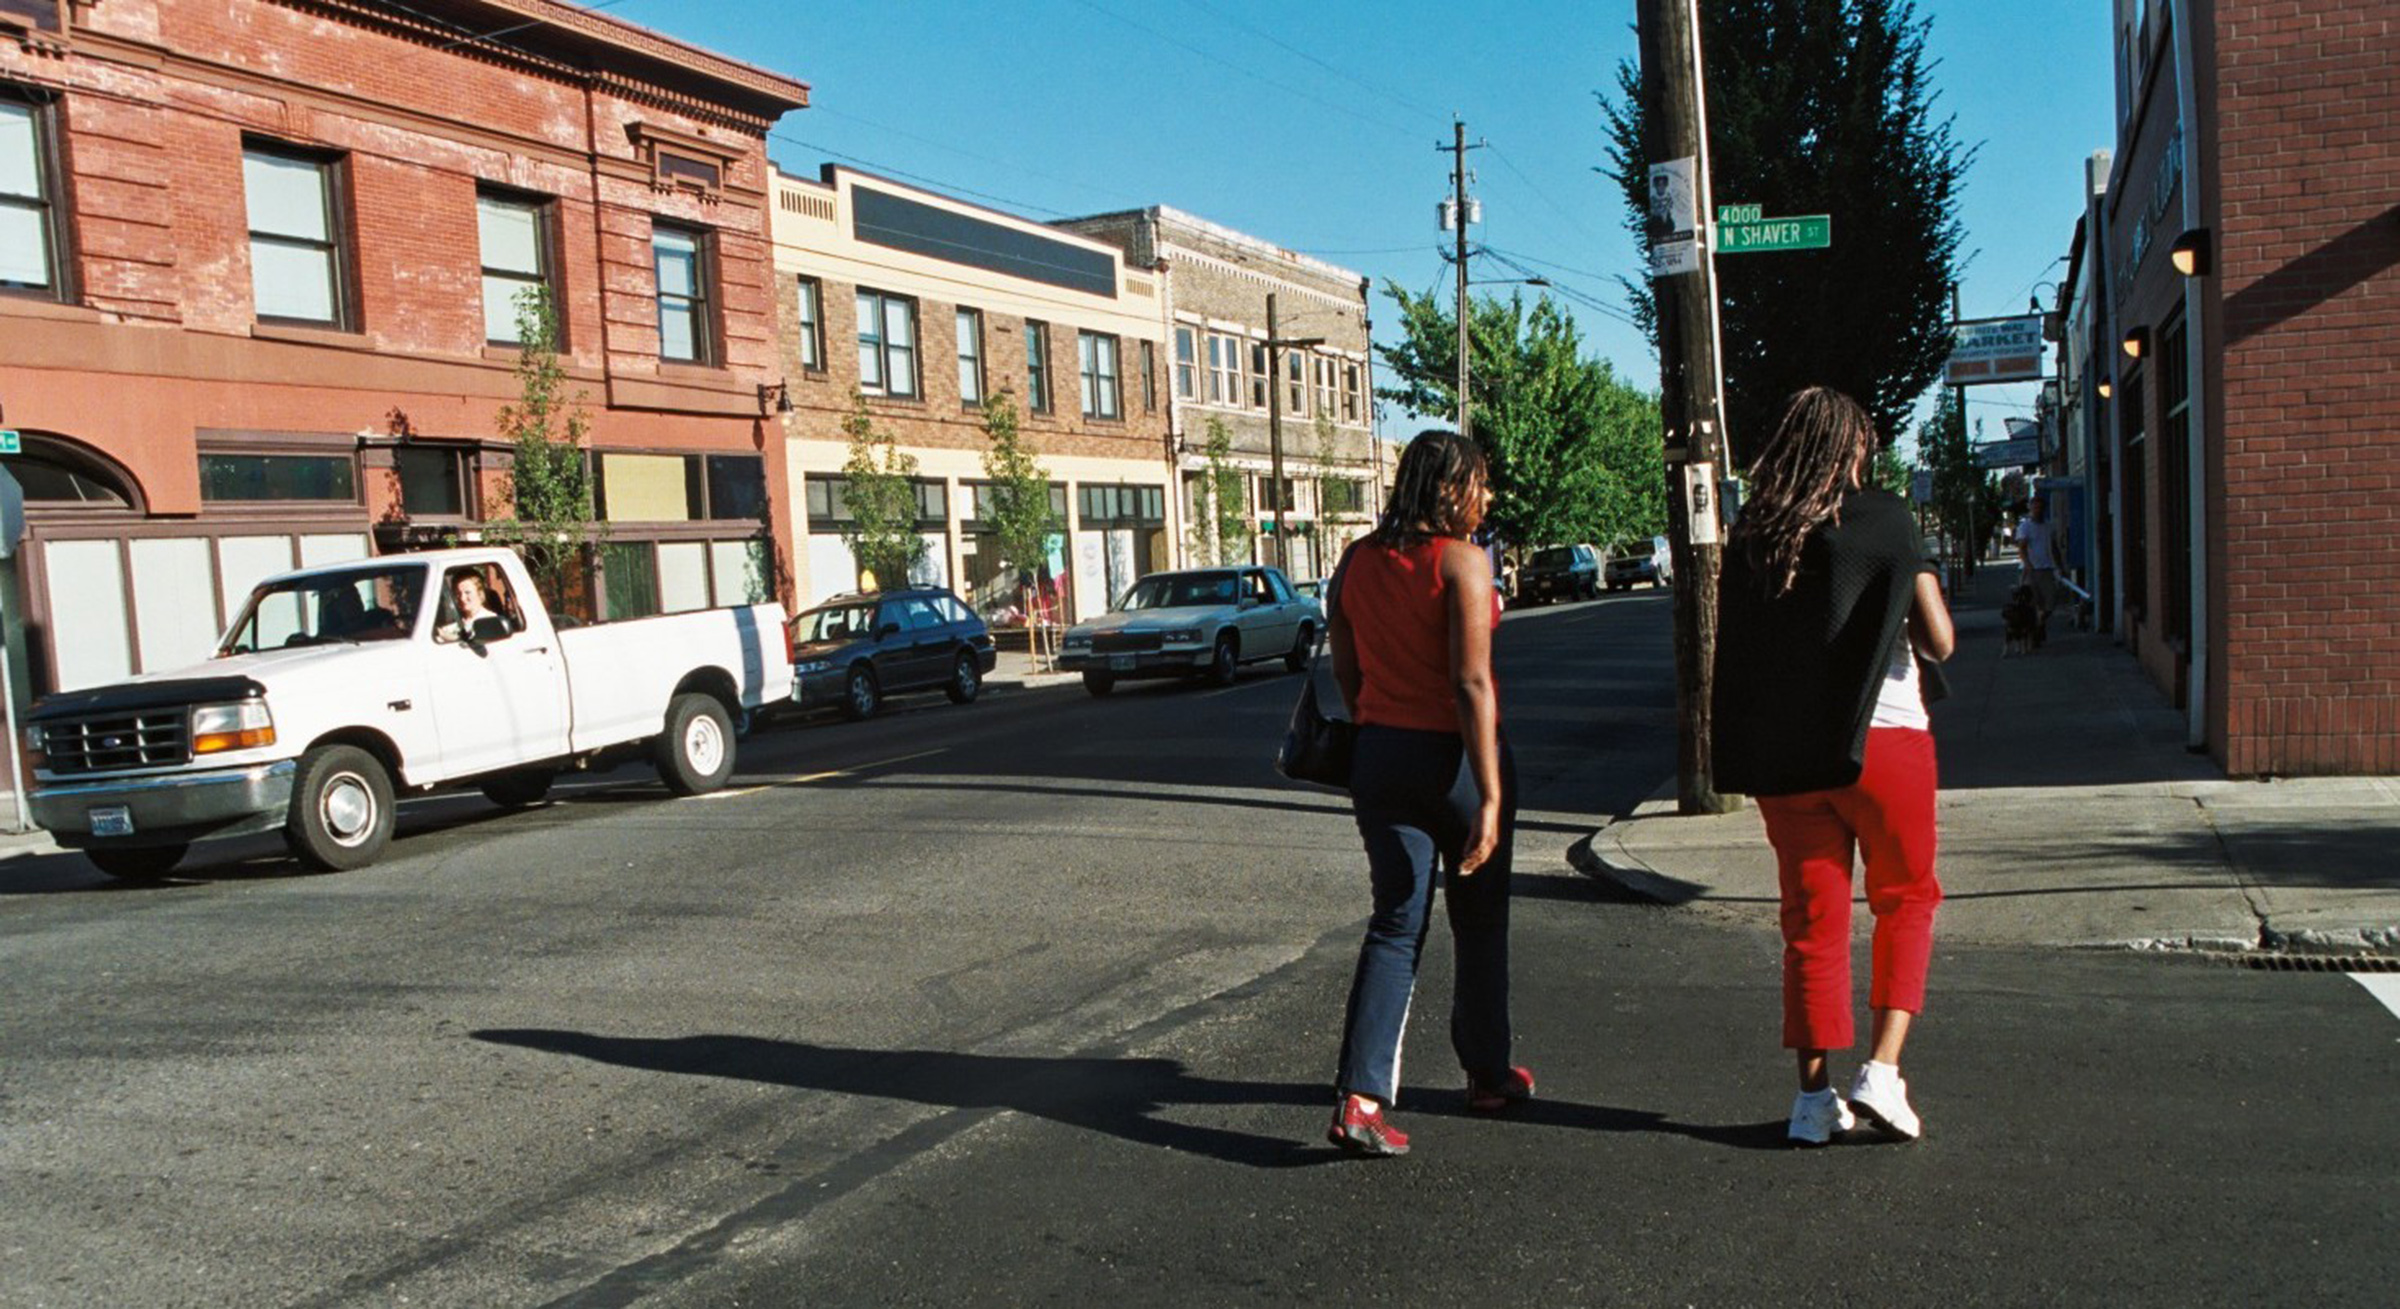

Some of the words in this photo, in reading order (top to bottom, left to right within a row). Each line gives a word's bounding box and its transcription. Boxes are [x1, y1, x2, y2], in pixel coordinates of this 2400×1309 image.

[1721, 206, 1760, 224] 4000
[1724, 226, 1735, 247] N
[1741, 222, 1800, 246] SHAVER
[1807, 226, 1819, 238] ST
[1958, 331, 2036, 348] MARKET
